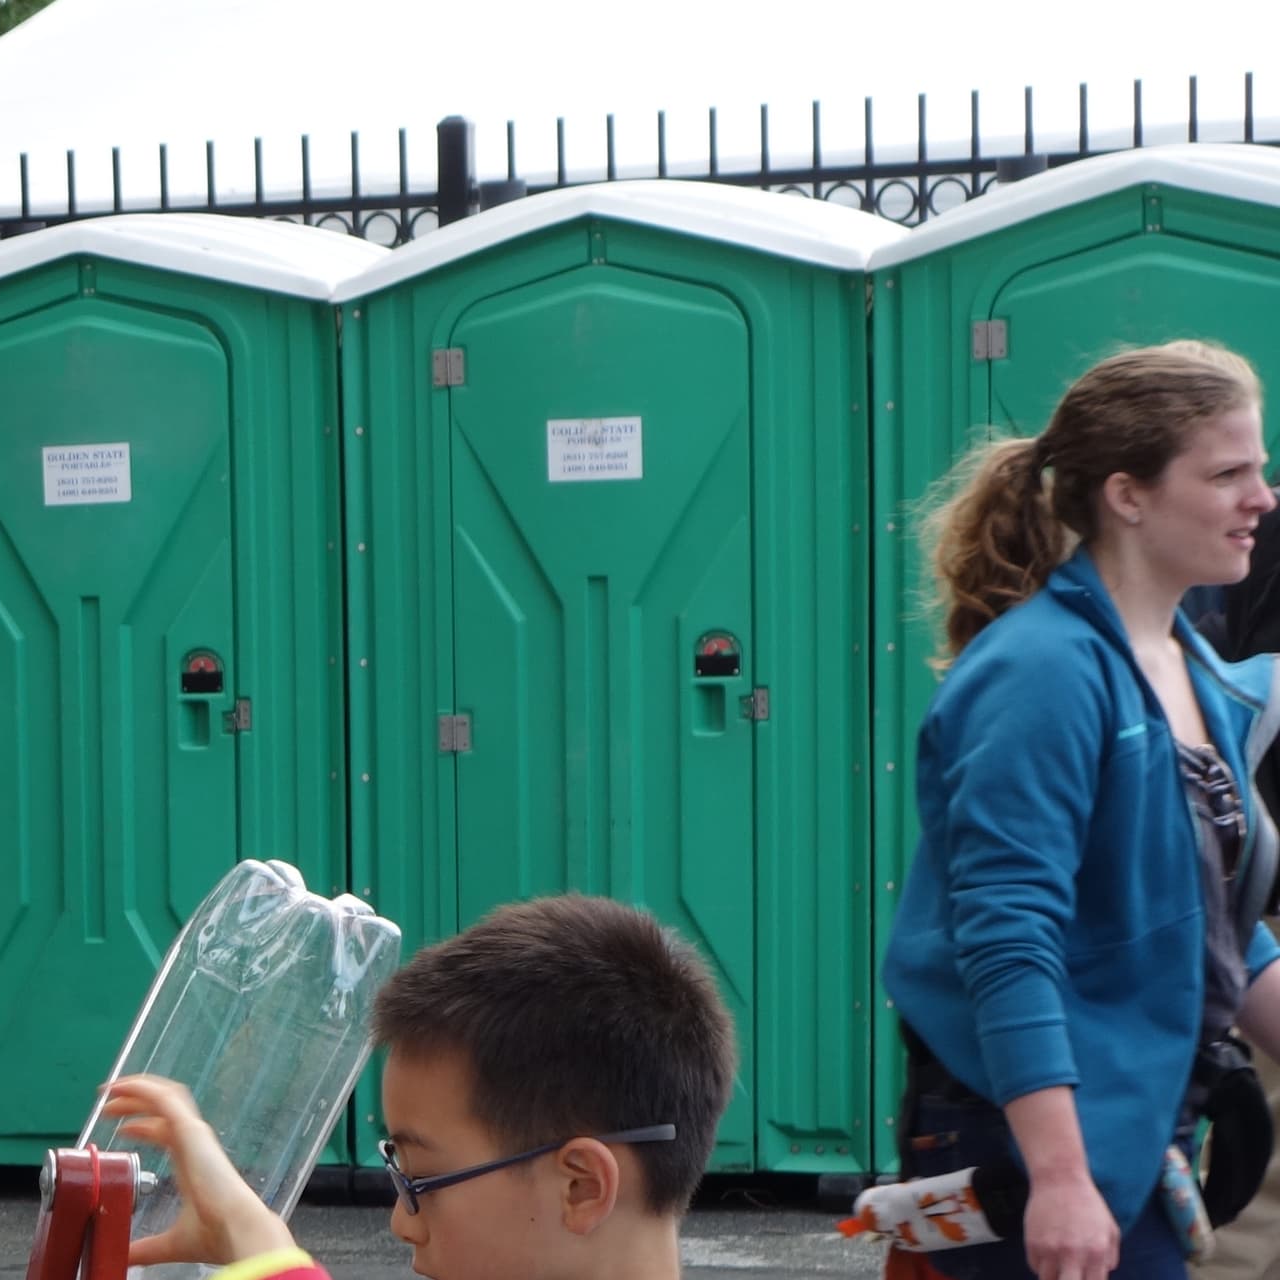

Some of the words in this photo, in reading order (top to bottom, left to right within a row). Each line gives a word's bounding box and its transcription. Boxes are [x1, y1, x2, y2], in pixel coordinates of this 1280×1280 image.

[600, 424, 637, 434] STATE
[47, 452, 89, 462] GOLDEN
[93, 450, 125, 460] STATE
[60, 461, 113, 471] PORTABLES
